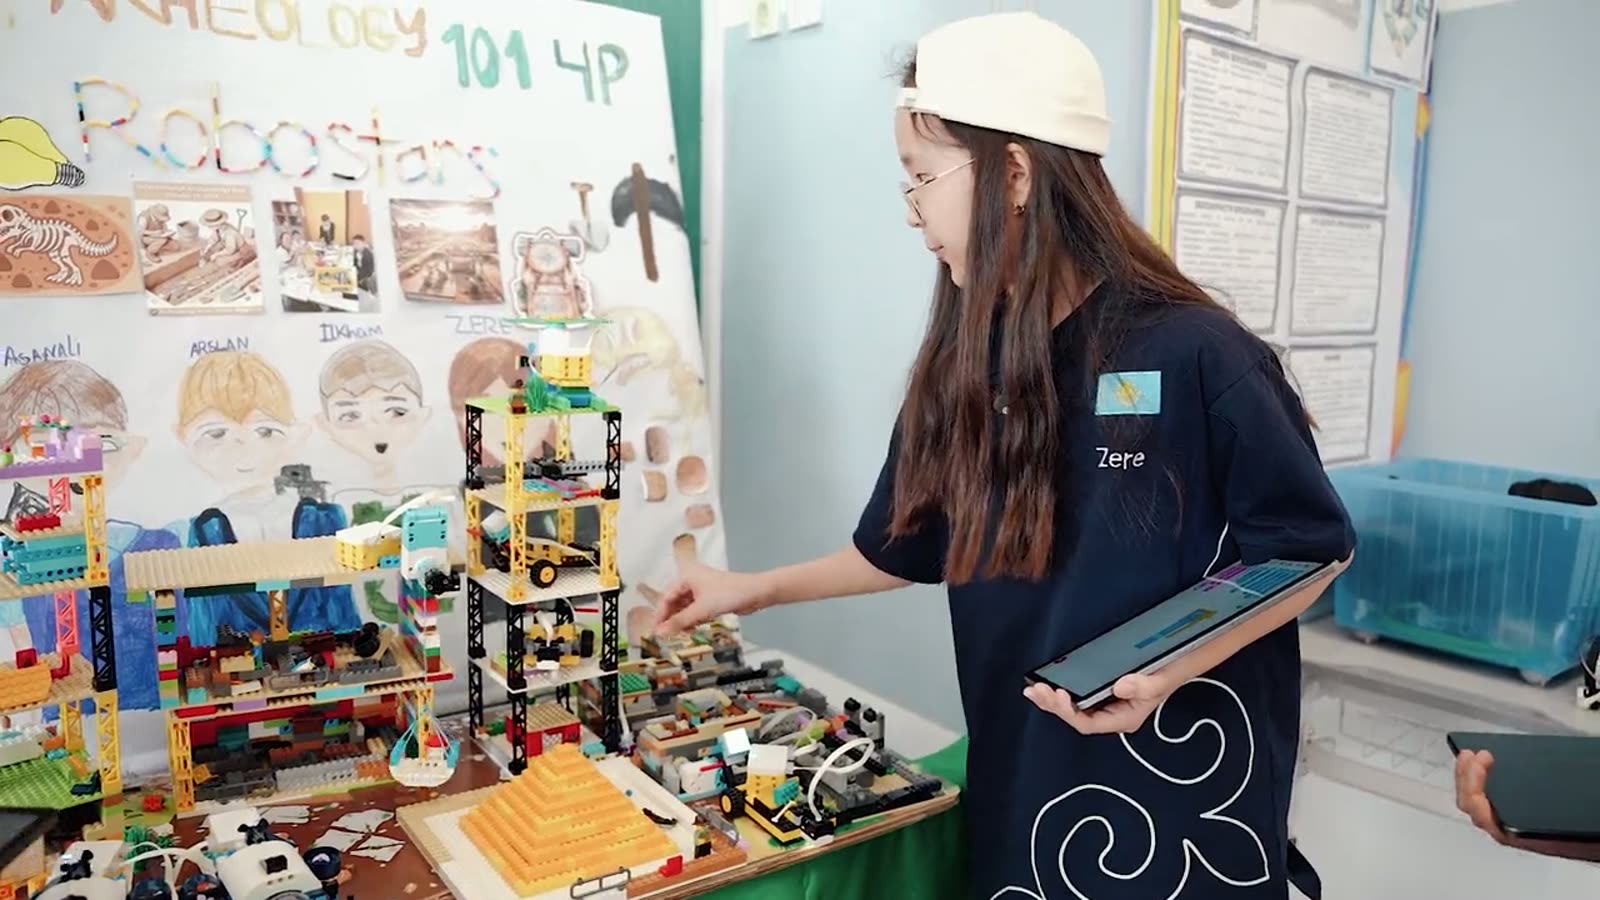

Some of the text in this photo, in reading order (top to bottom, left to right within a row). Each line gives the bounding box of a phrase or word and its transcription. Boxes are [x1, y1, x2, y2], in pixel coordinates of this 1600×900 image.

[441, 23, 532, 90] 101
[553, 39, 630, 106] 4P
[73, 75, 502, 199] Robostars
[445, 315, 513, 335] ZERE
[190, 336, 250, 358] ARSLAN
[1095, 446, 1146, 470] Zere
